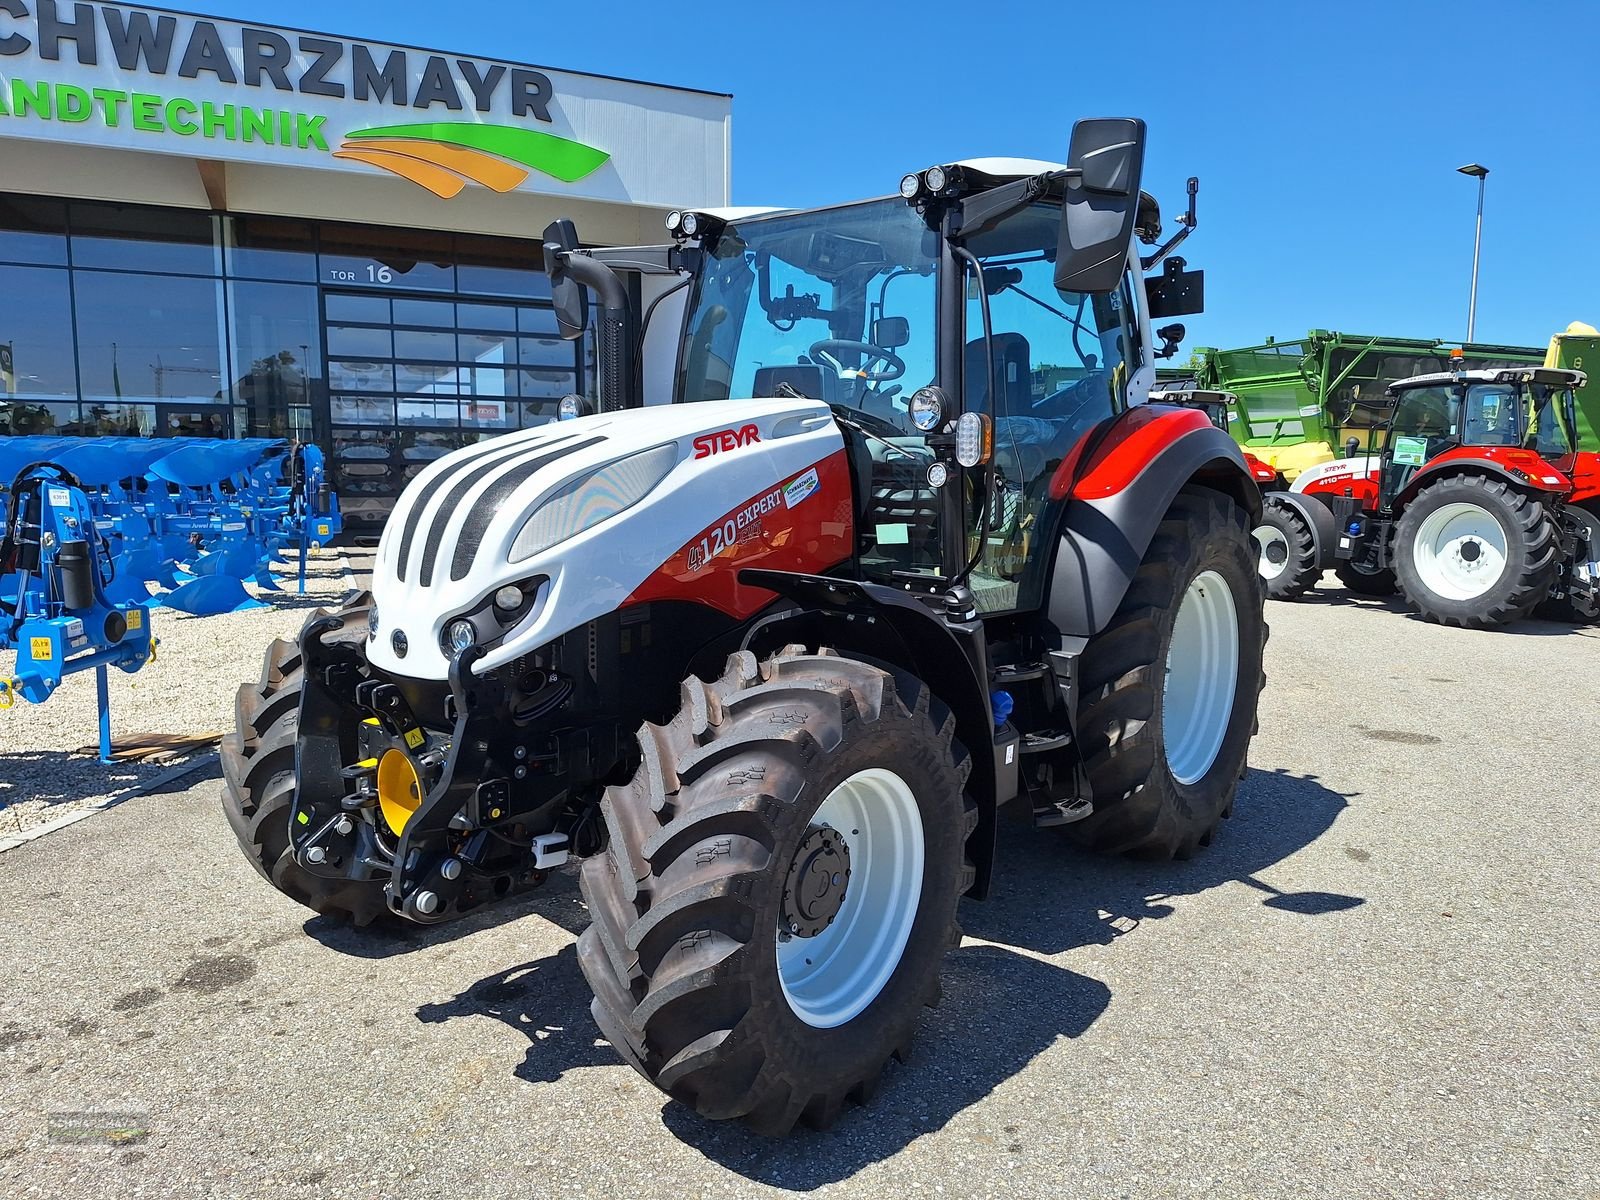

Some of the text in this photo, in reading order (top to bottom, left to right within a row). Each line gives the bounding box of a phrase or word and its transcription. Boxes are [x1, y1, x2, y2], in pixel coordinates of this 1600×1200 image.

[0, 79, 329, 151] NDTECHNIK
[330, 264, 392, 283] TOR 16
[692, 423, 761, 460] STEYR
[1318, 477, 1338, 485] 4110
[1324, 464, 1347, 473] STEYR
[737, 489, 781, 529] EXPERT
